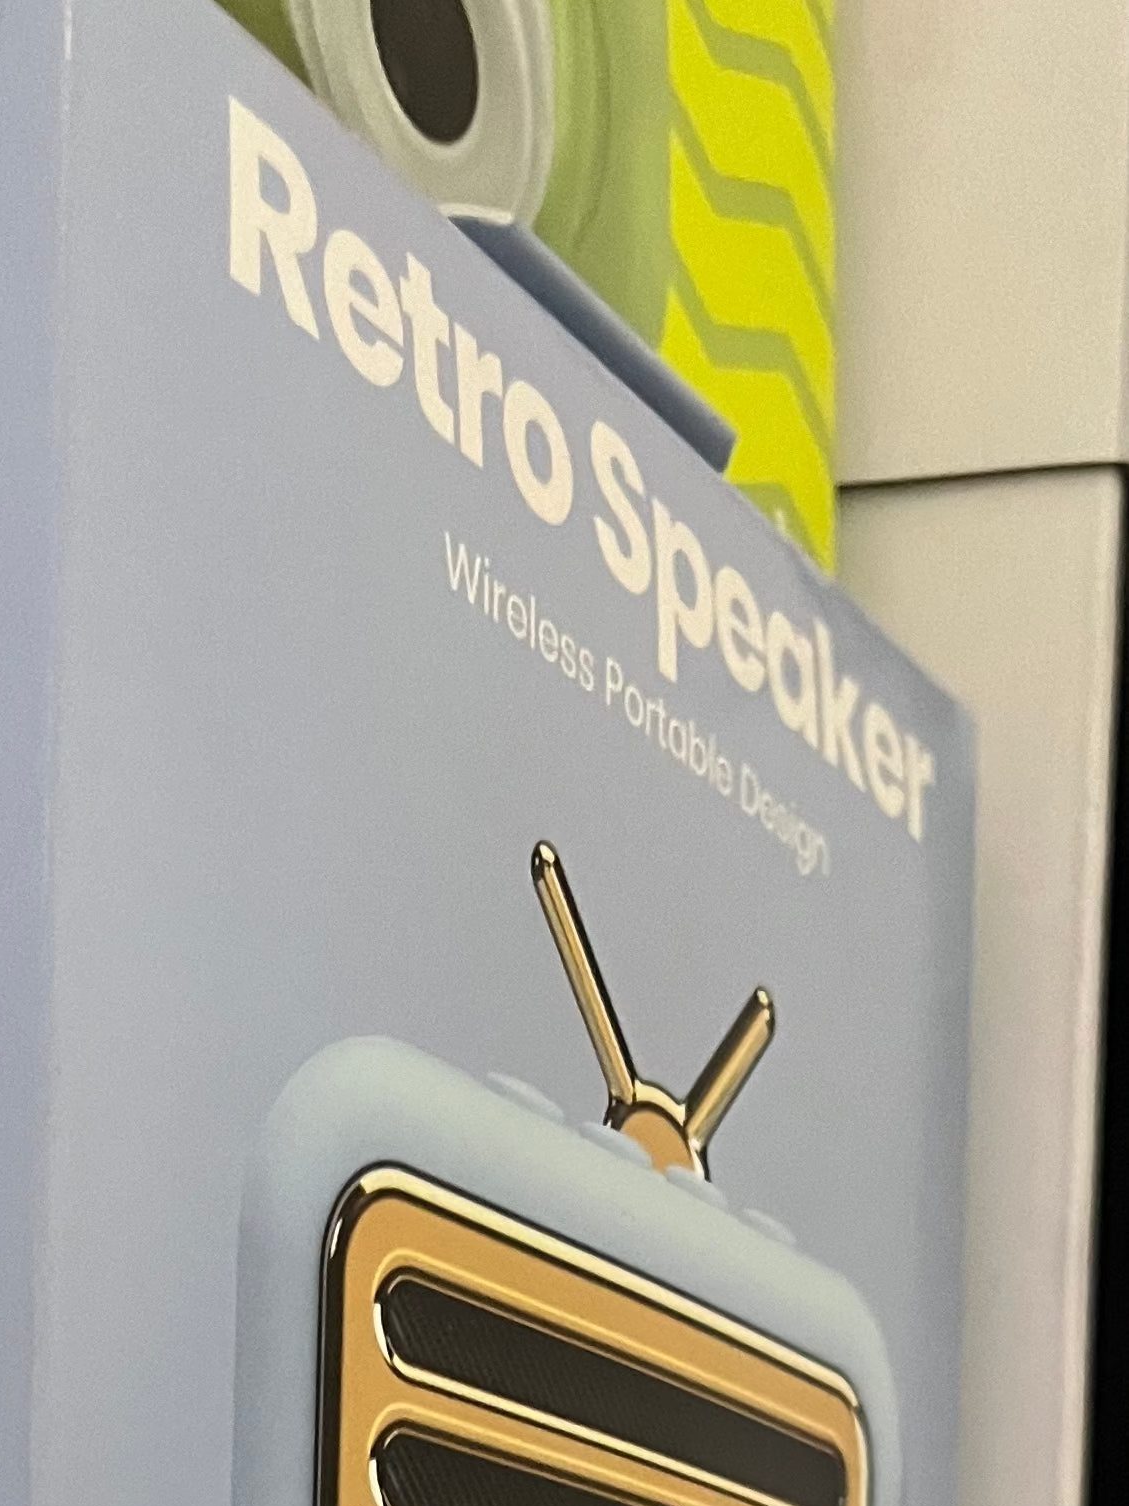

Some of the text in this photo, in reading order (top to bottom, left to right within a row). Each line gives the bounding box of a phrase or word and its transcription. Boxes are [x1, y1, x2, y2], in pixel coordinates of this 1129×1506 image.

[227, 94, 936, 843] Retro Speaker
[444, 530, 832, 877] Wireless Portable Design
